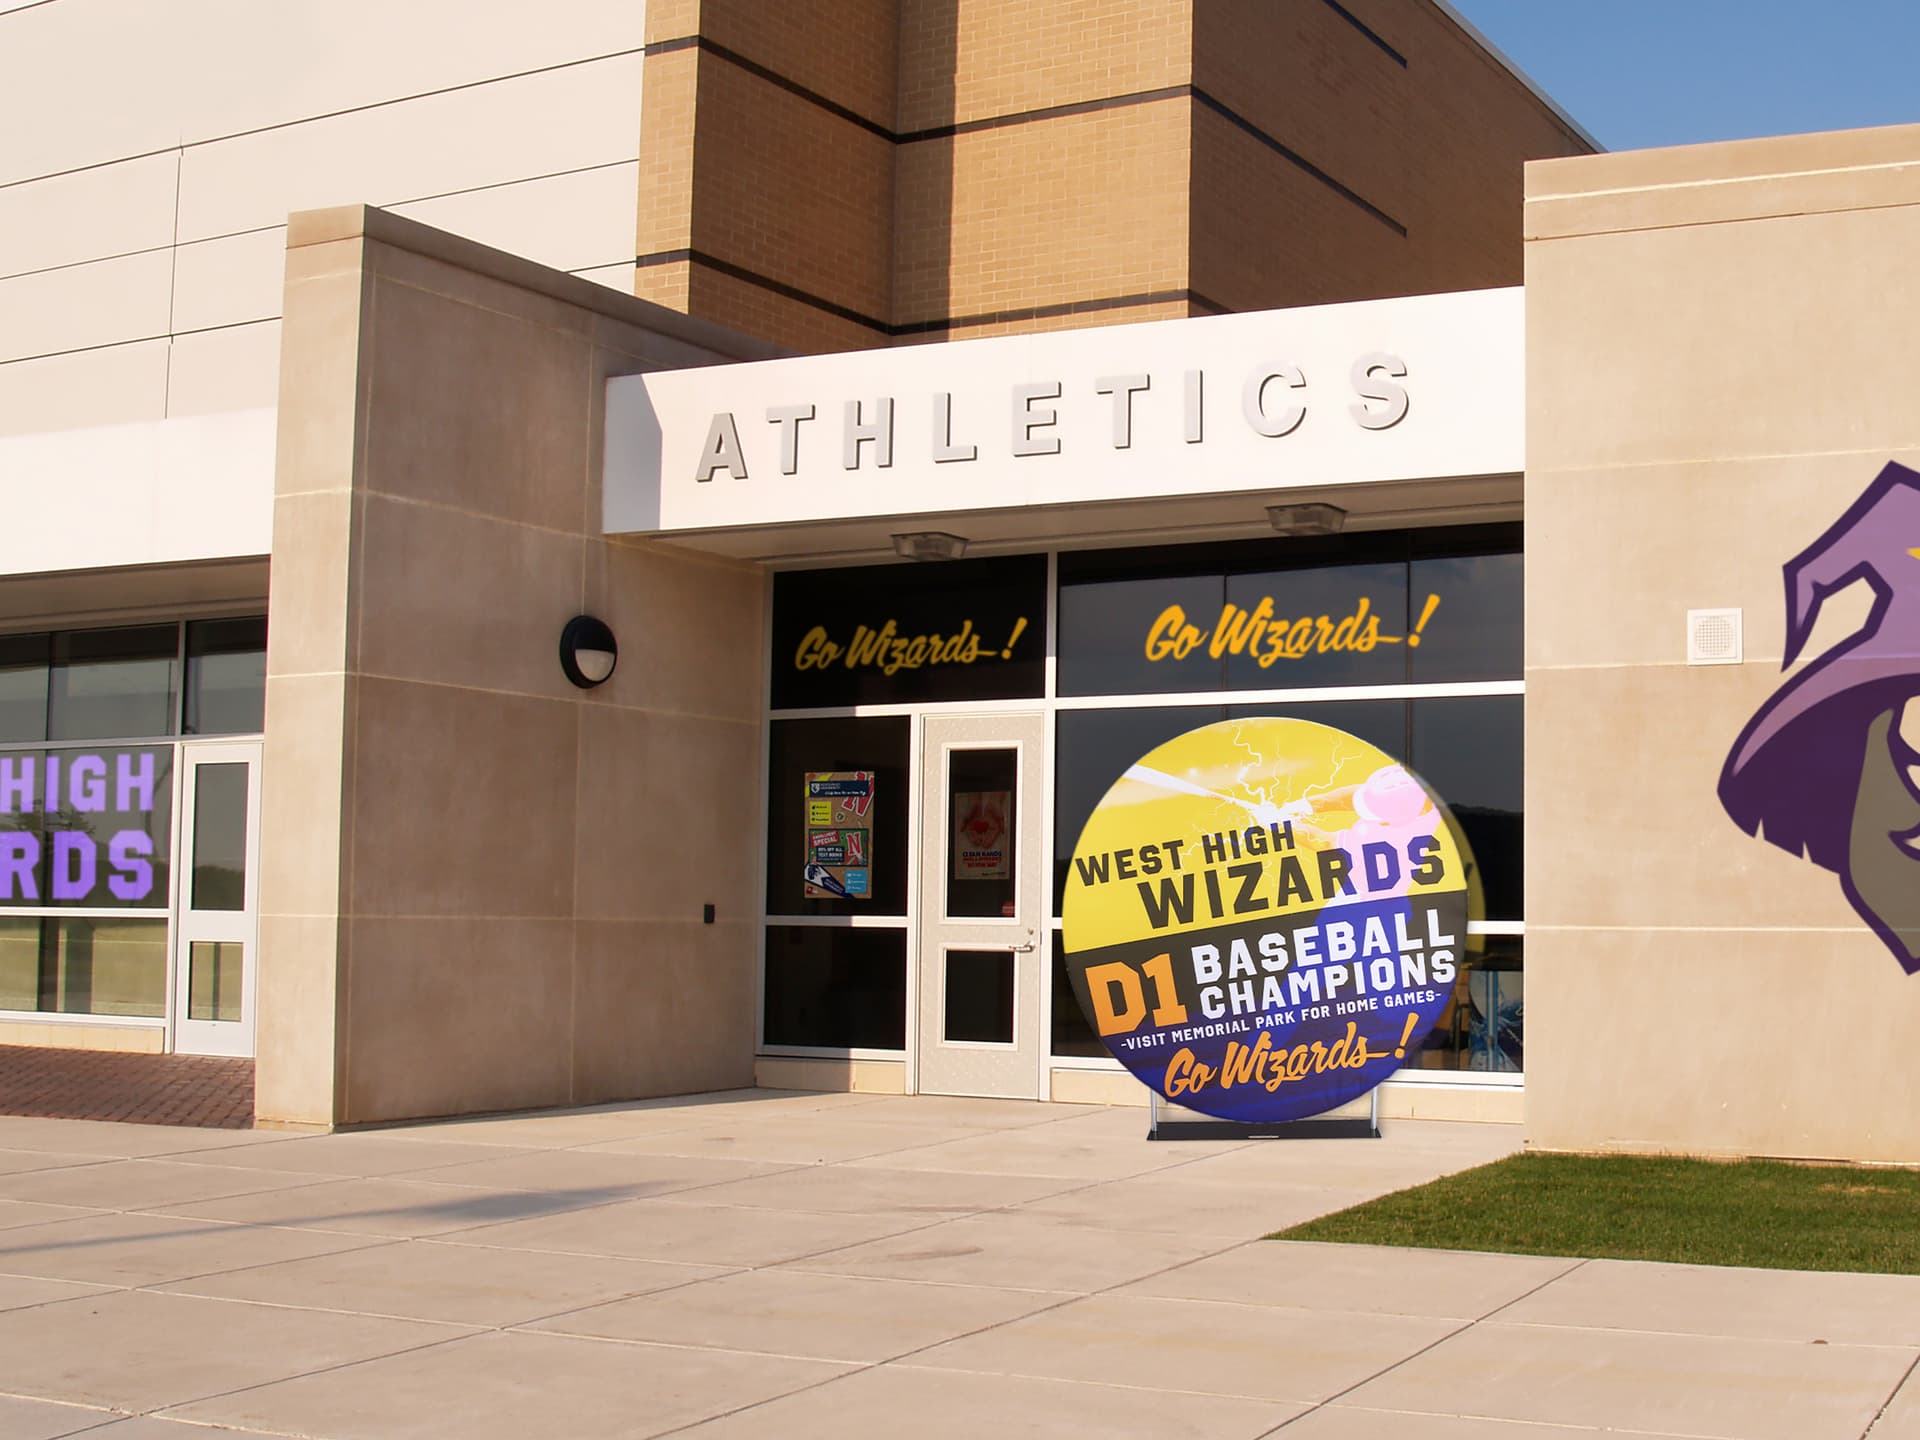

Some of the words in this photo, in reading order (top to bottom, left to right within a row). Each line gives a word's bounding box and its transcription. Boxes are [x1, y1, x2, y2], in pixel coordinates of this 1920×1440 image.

[695, 351, 1411, 482] ATHLETICS
[795, 625, 841, 671] Go
[1145, 604, 1210, 663] Go
[0, 753, 154, 813] HIGH
[1076, 839, 1185, 887] WEST
[1202, 820, 1295, 865] HIGH
[1137, 834, 1446, 930] WIZARDS
[1191, 908, 1456, 985] BASEBALL
[1085, 953, 1187, 1037] D1
[1199, 949, 1456, 1020] CHAMPIONS
[1172, 1018, 1250, 1042] MEMORIAL
[1255, 1012, 1296, 1028] PARK
[1301, 1006, 1331, 1020] FOR
[1336, 998, 1379, 1015] HOME
[1164, 1046, 1217, 1098] Go
